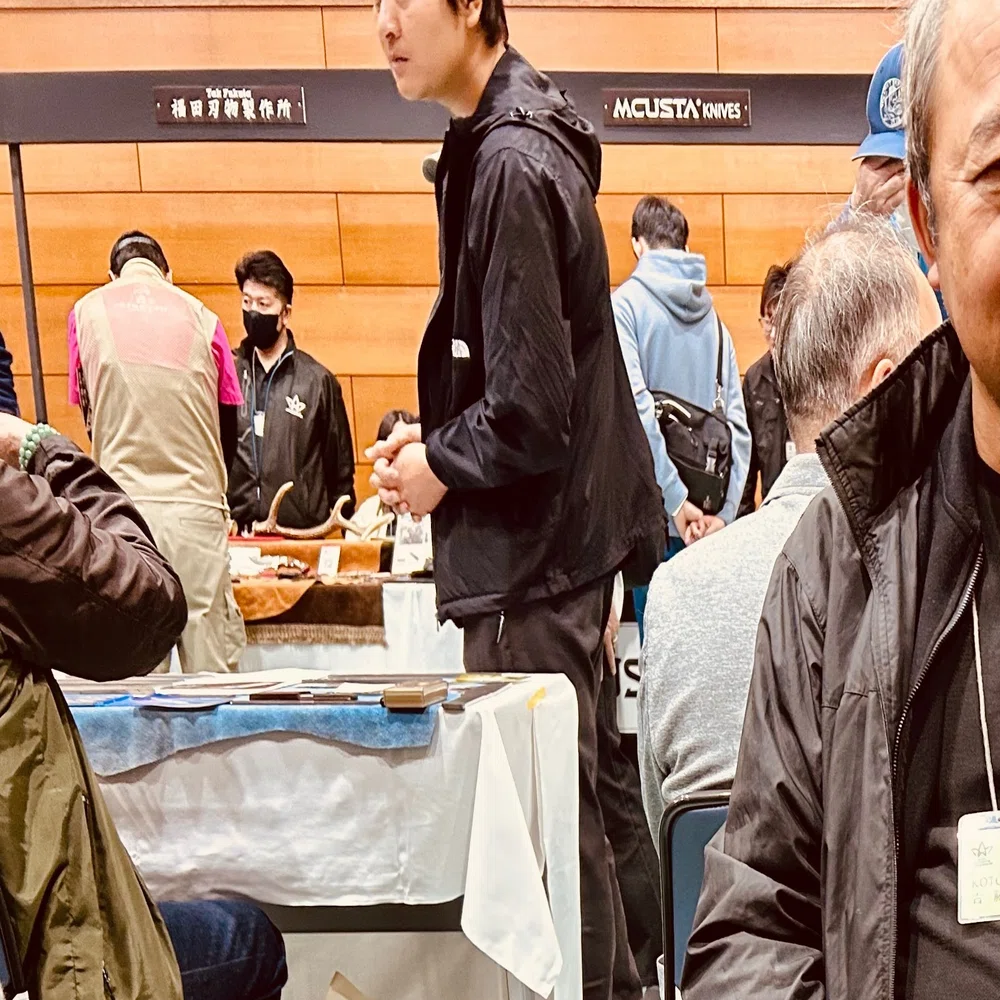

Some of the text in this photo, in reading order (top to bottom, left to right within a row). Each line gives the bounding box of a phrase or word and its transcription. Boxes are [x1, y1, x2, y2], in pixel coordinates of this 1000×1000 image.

[171, 98, 292, 120] 福田刃物製作所
[612, 97, 741, 119] MCUSTA KNIVES
